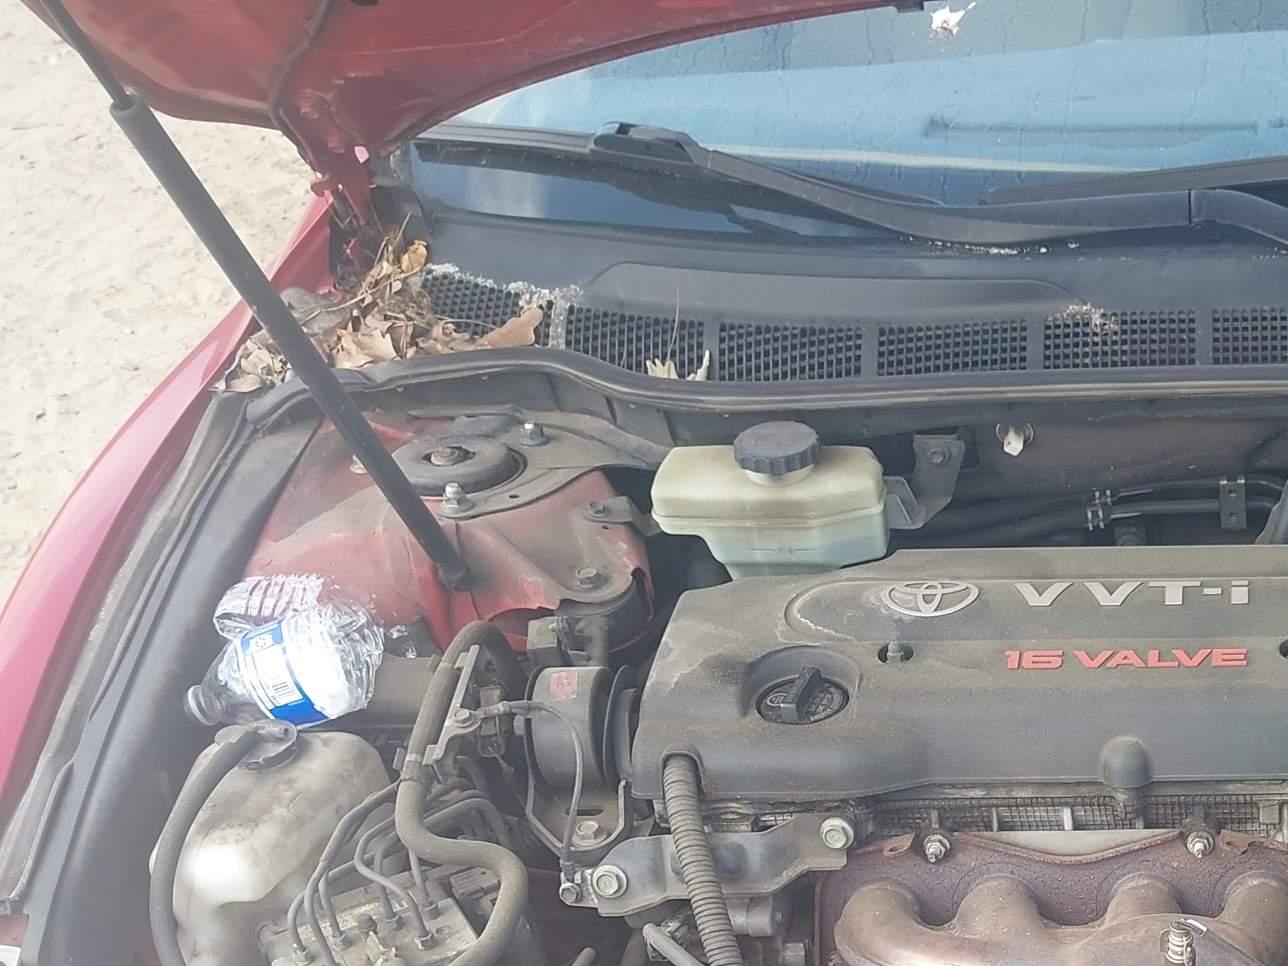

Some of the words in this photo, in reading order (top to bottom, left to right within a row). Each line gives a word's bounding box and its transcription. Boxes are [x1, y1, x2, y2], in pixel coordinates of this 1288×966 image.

[1013, 580, 1249, 607] VVT-i
[1005, 650, 1064, 669] 16
[1073, 648, 1248, 669] VALVE
